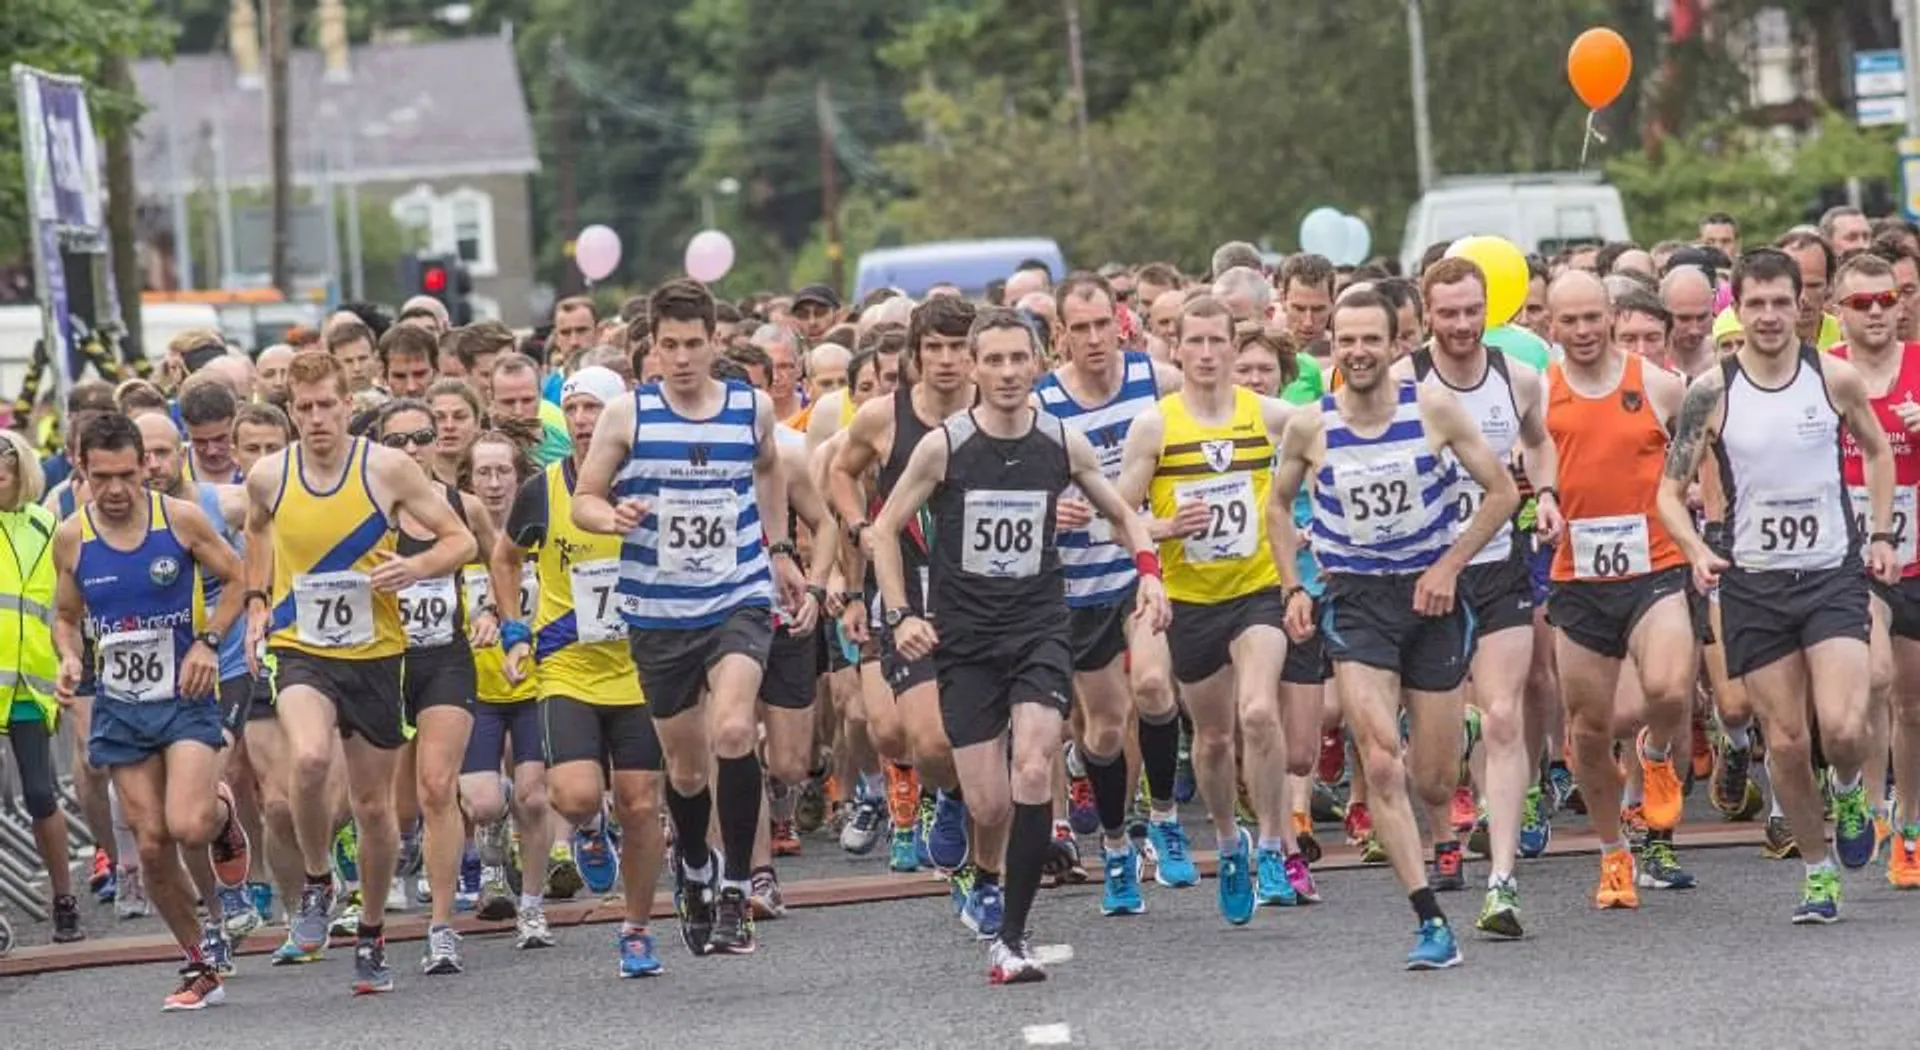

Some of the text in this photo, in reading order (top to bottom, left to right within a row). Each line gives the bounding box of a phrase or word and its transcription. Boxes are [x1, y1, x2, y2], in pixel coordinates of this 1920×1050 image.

[1350, 480, 1413, 521] 532
[668, 516, 726, 549] 536
[974, 518, 1033, 554] 508
[1761, 515, 1819, 551] 599
[1854, 511, 1908, 546] 42
[1593, 542, 1629, 577] 66
[314, 594, 353, 630] 76
[398, 597, 448, 629] 549
[112, 651, 164, 683] 586
